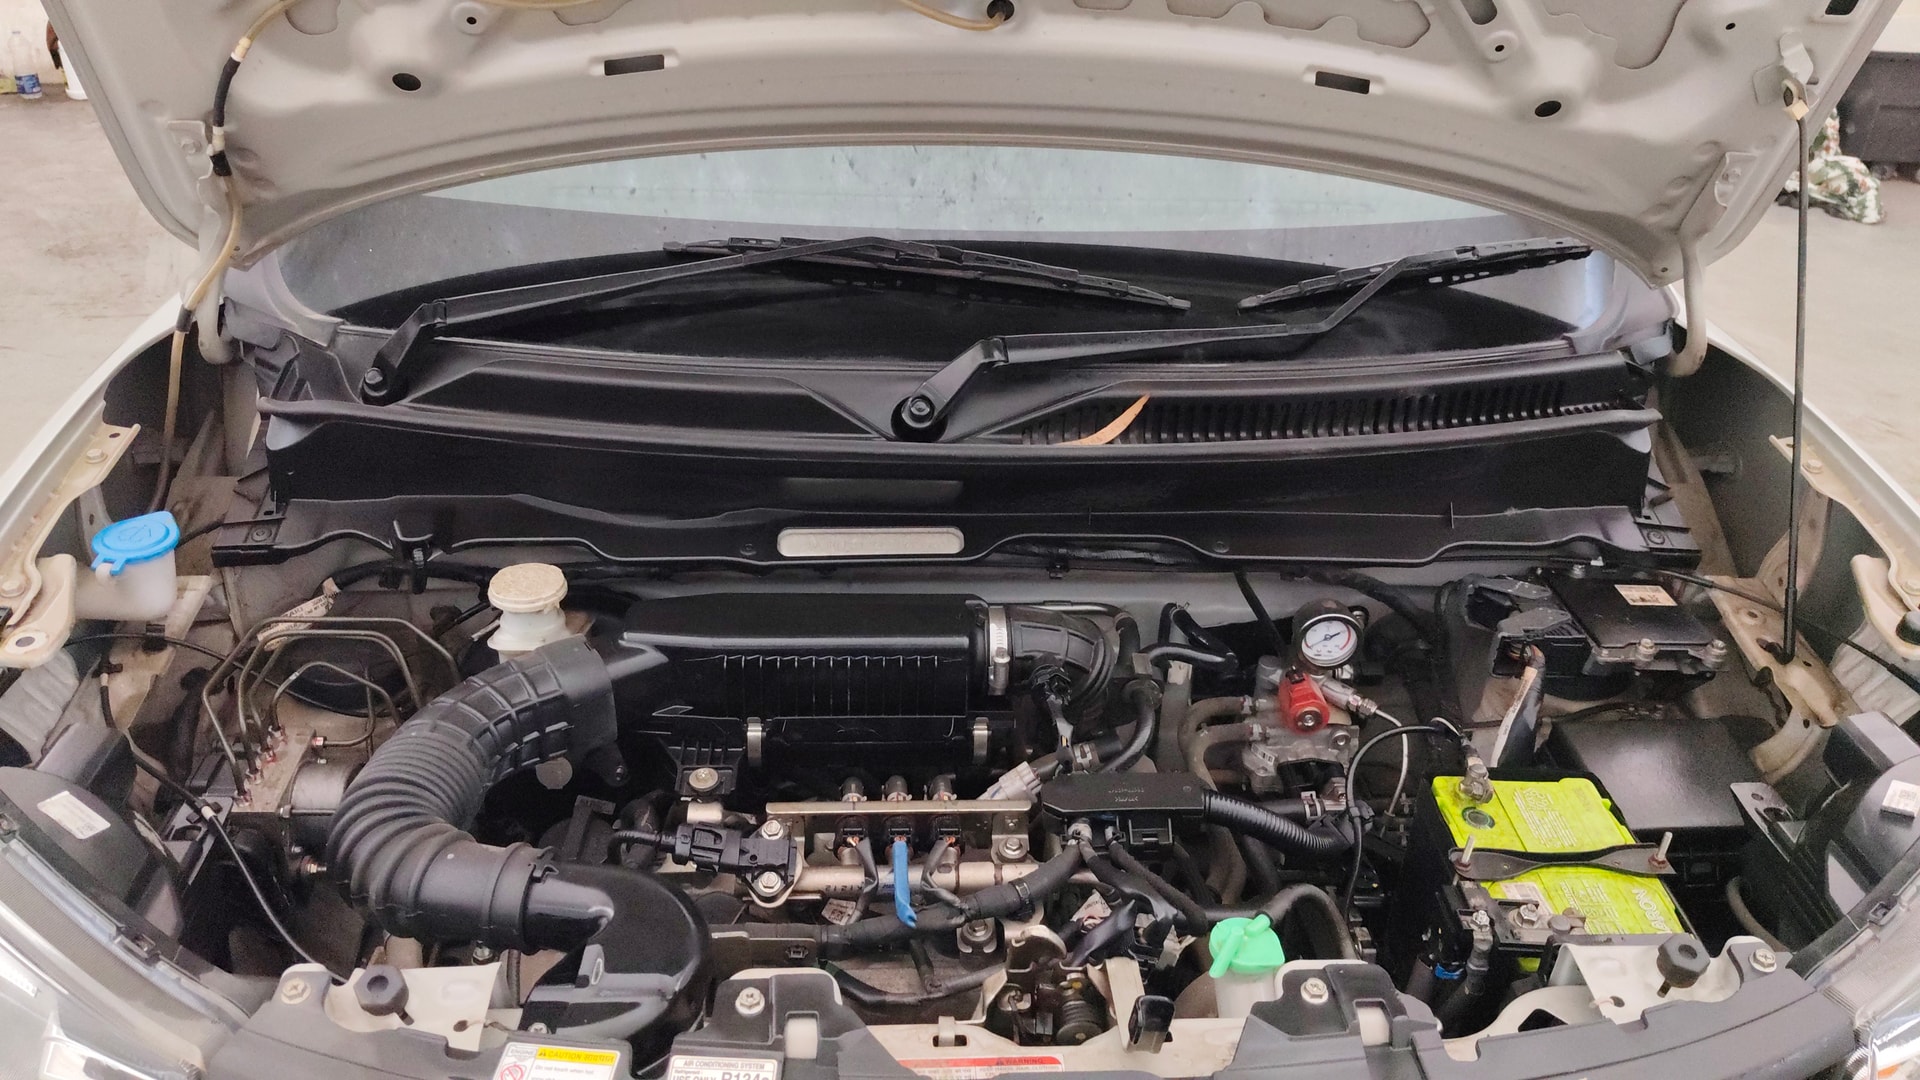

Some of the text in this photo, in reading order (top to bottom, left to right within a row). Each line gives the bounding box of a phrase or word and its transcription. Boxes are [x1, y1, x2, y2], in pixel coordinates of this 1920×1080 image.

[548, 1051, 582, 1061] CAUTION
[695, 1060, 738, 1069] CONDITIONING
[740, 1062, 765, 1070] SYSTEM
